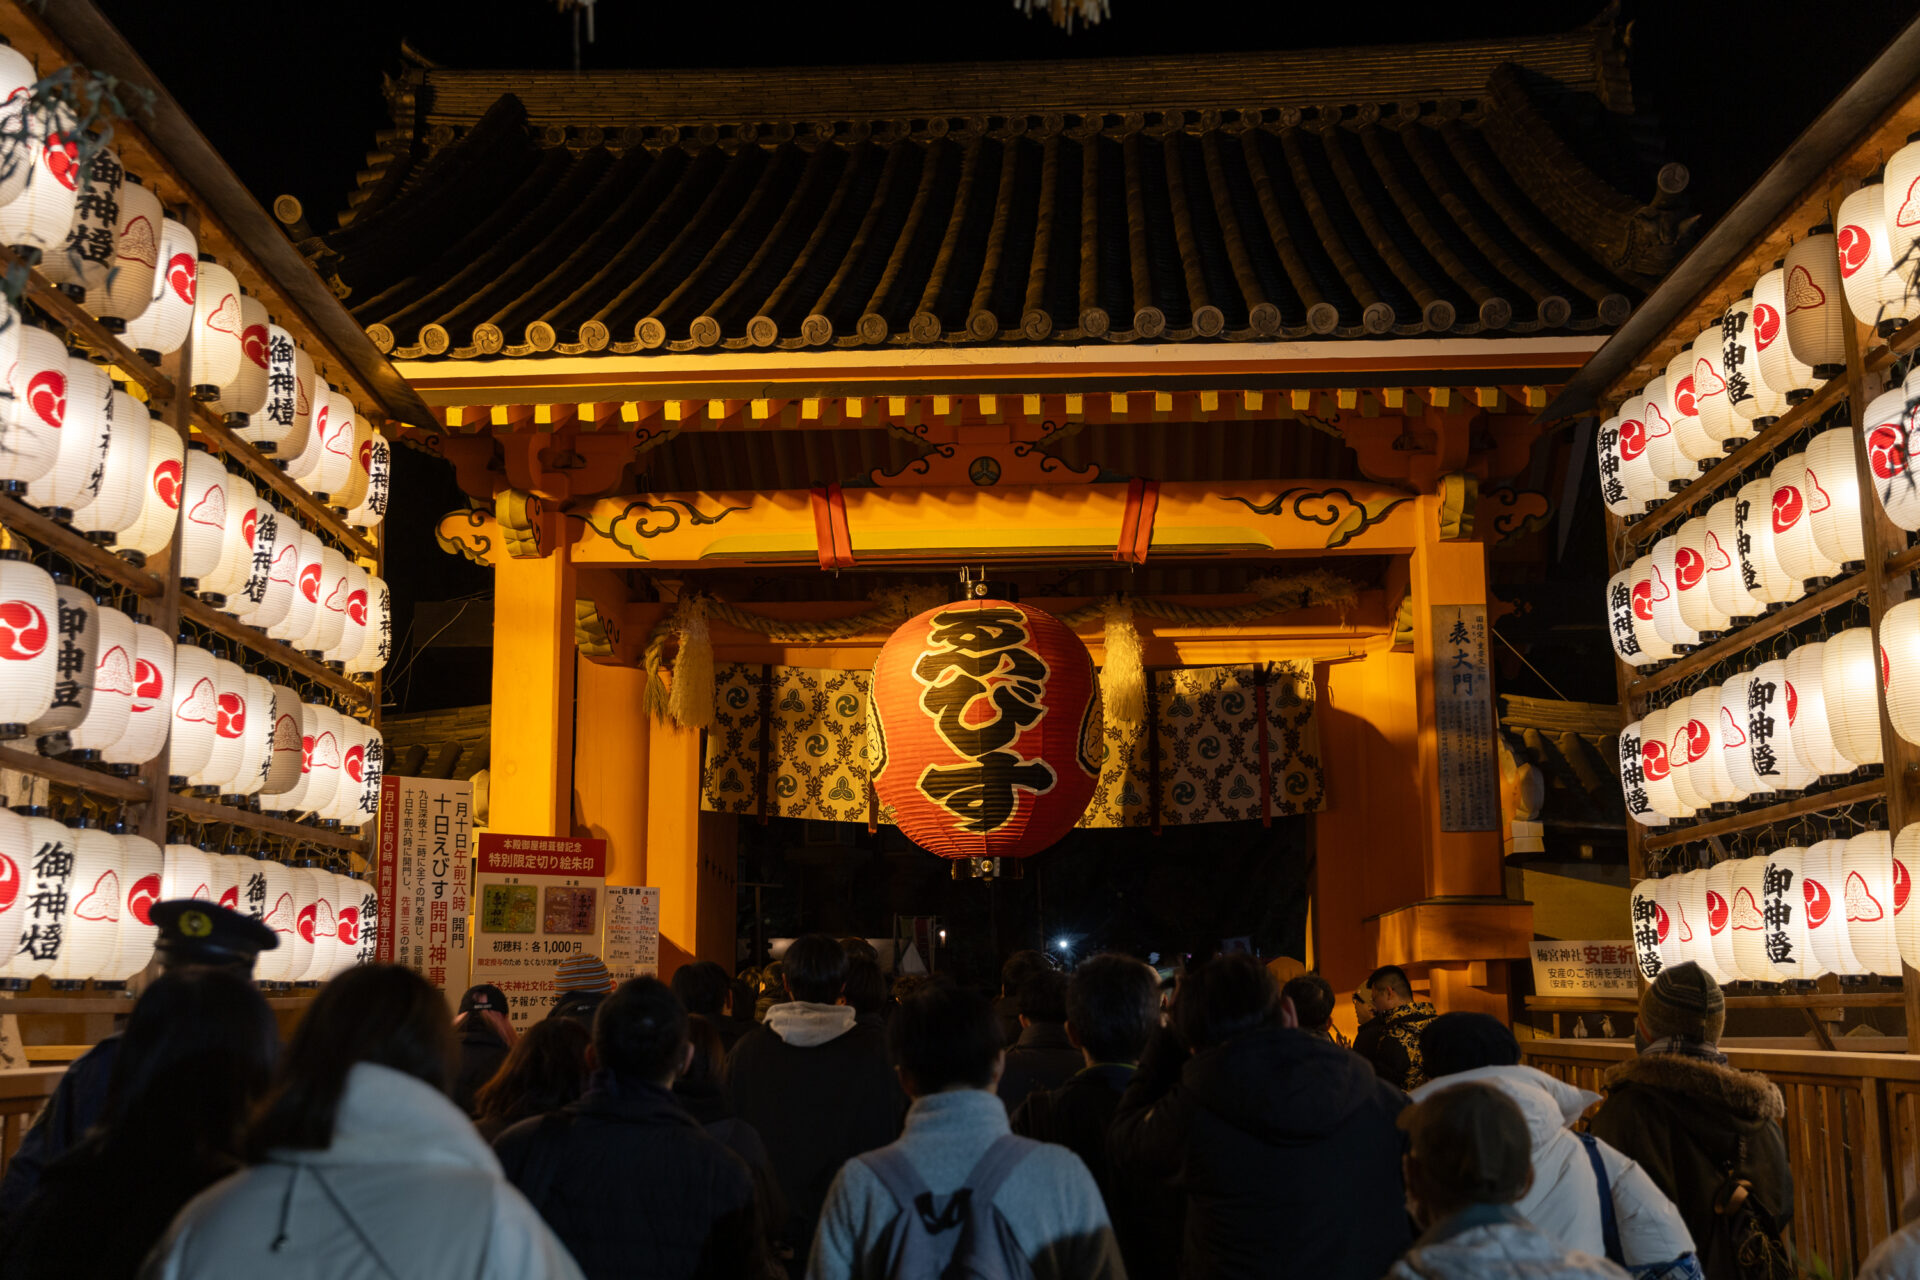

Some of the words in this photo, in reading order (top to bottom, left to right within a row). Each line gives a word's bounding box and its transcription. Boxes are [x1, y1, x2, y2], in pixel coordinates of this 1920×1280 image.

[1448, 620, 1474, 697] 表大門
[452, 791, 470, 912] 一月十日午前六時
[488, 852, 594, 871] 特別限定切り絵朱印
[20, 841, 74, 961] 御神燈
[400, 896, 411, 968] 先着三名の参拝
[451, 917, 465, 949] 開門
[1583, 945, 1638, 965] 安産祈
